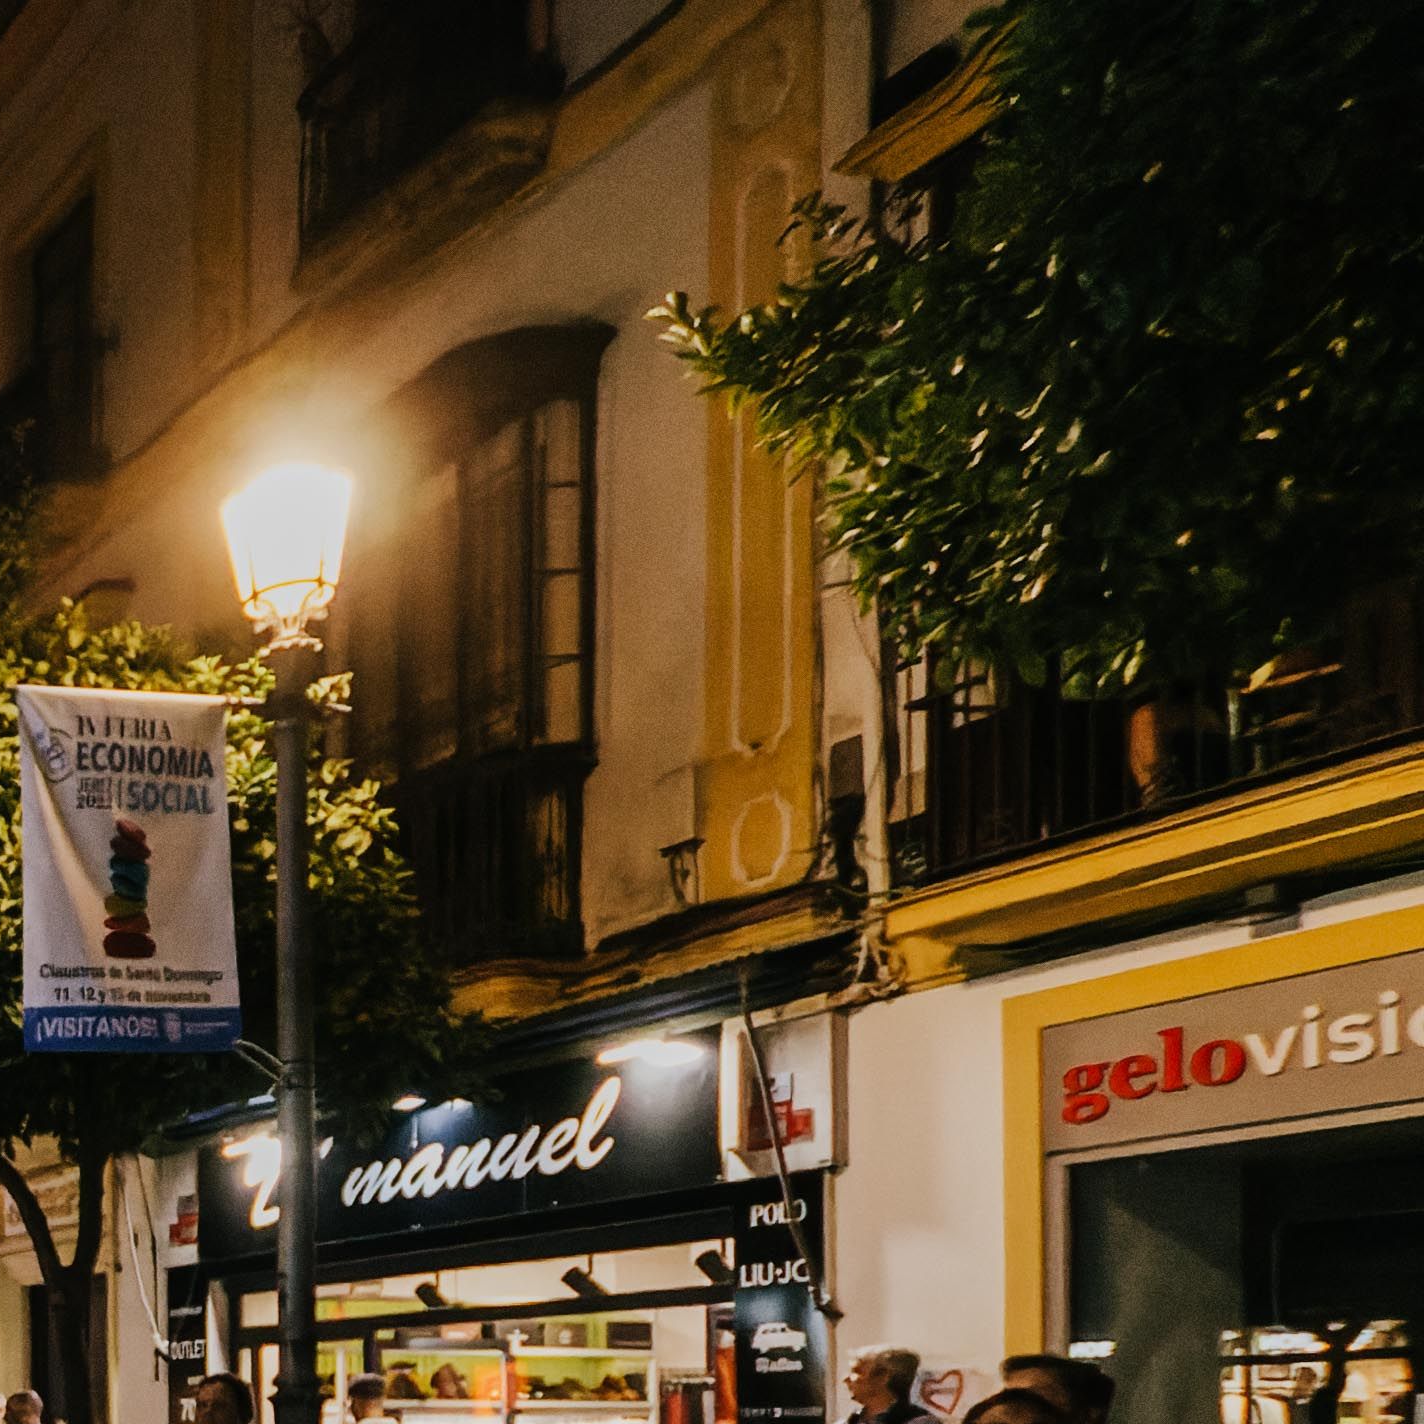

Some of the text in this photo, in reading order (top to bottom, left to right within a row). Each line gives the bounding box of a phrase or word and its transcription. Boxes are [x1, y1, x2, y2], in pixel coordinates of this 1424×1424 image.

[126, 779, 216, 815] SOCIAL
[749, 1198, 808, 1229] POLO
[170, 1339, 206, 1361] OUTLET
